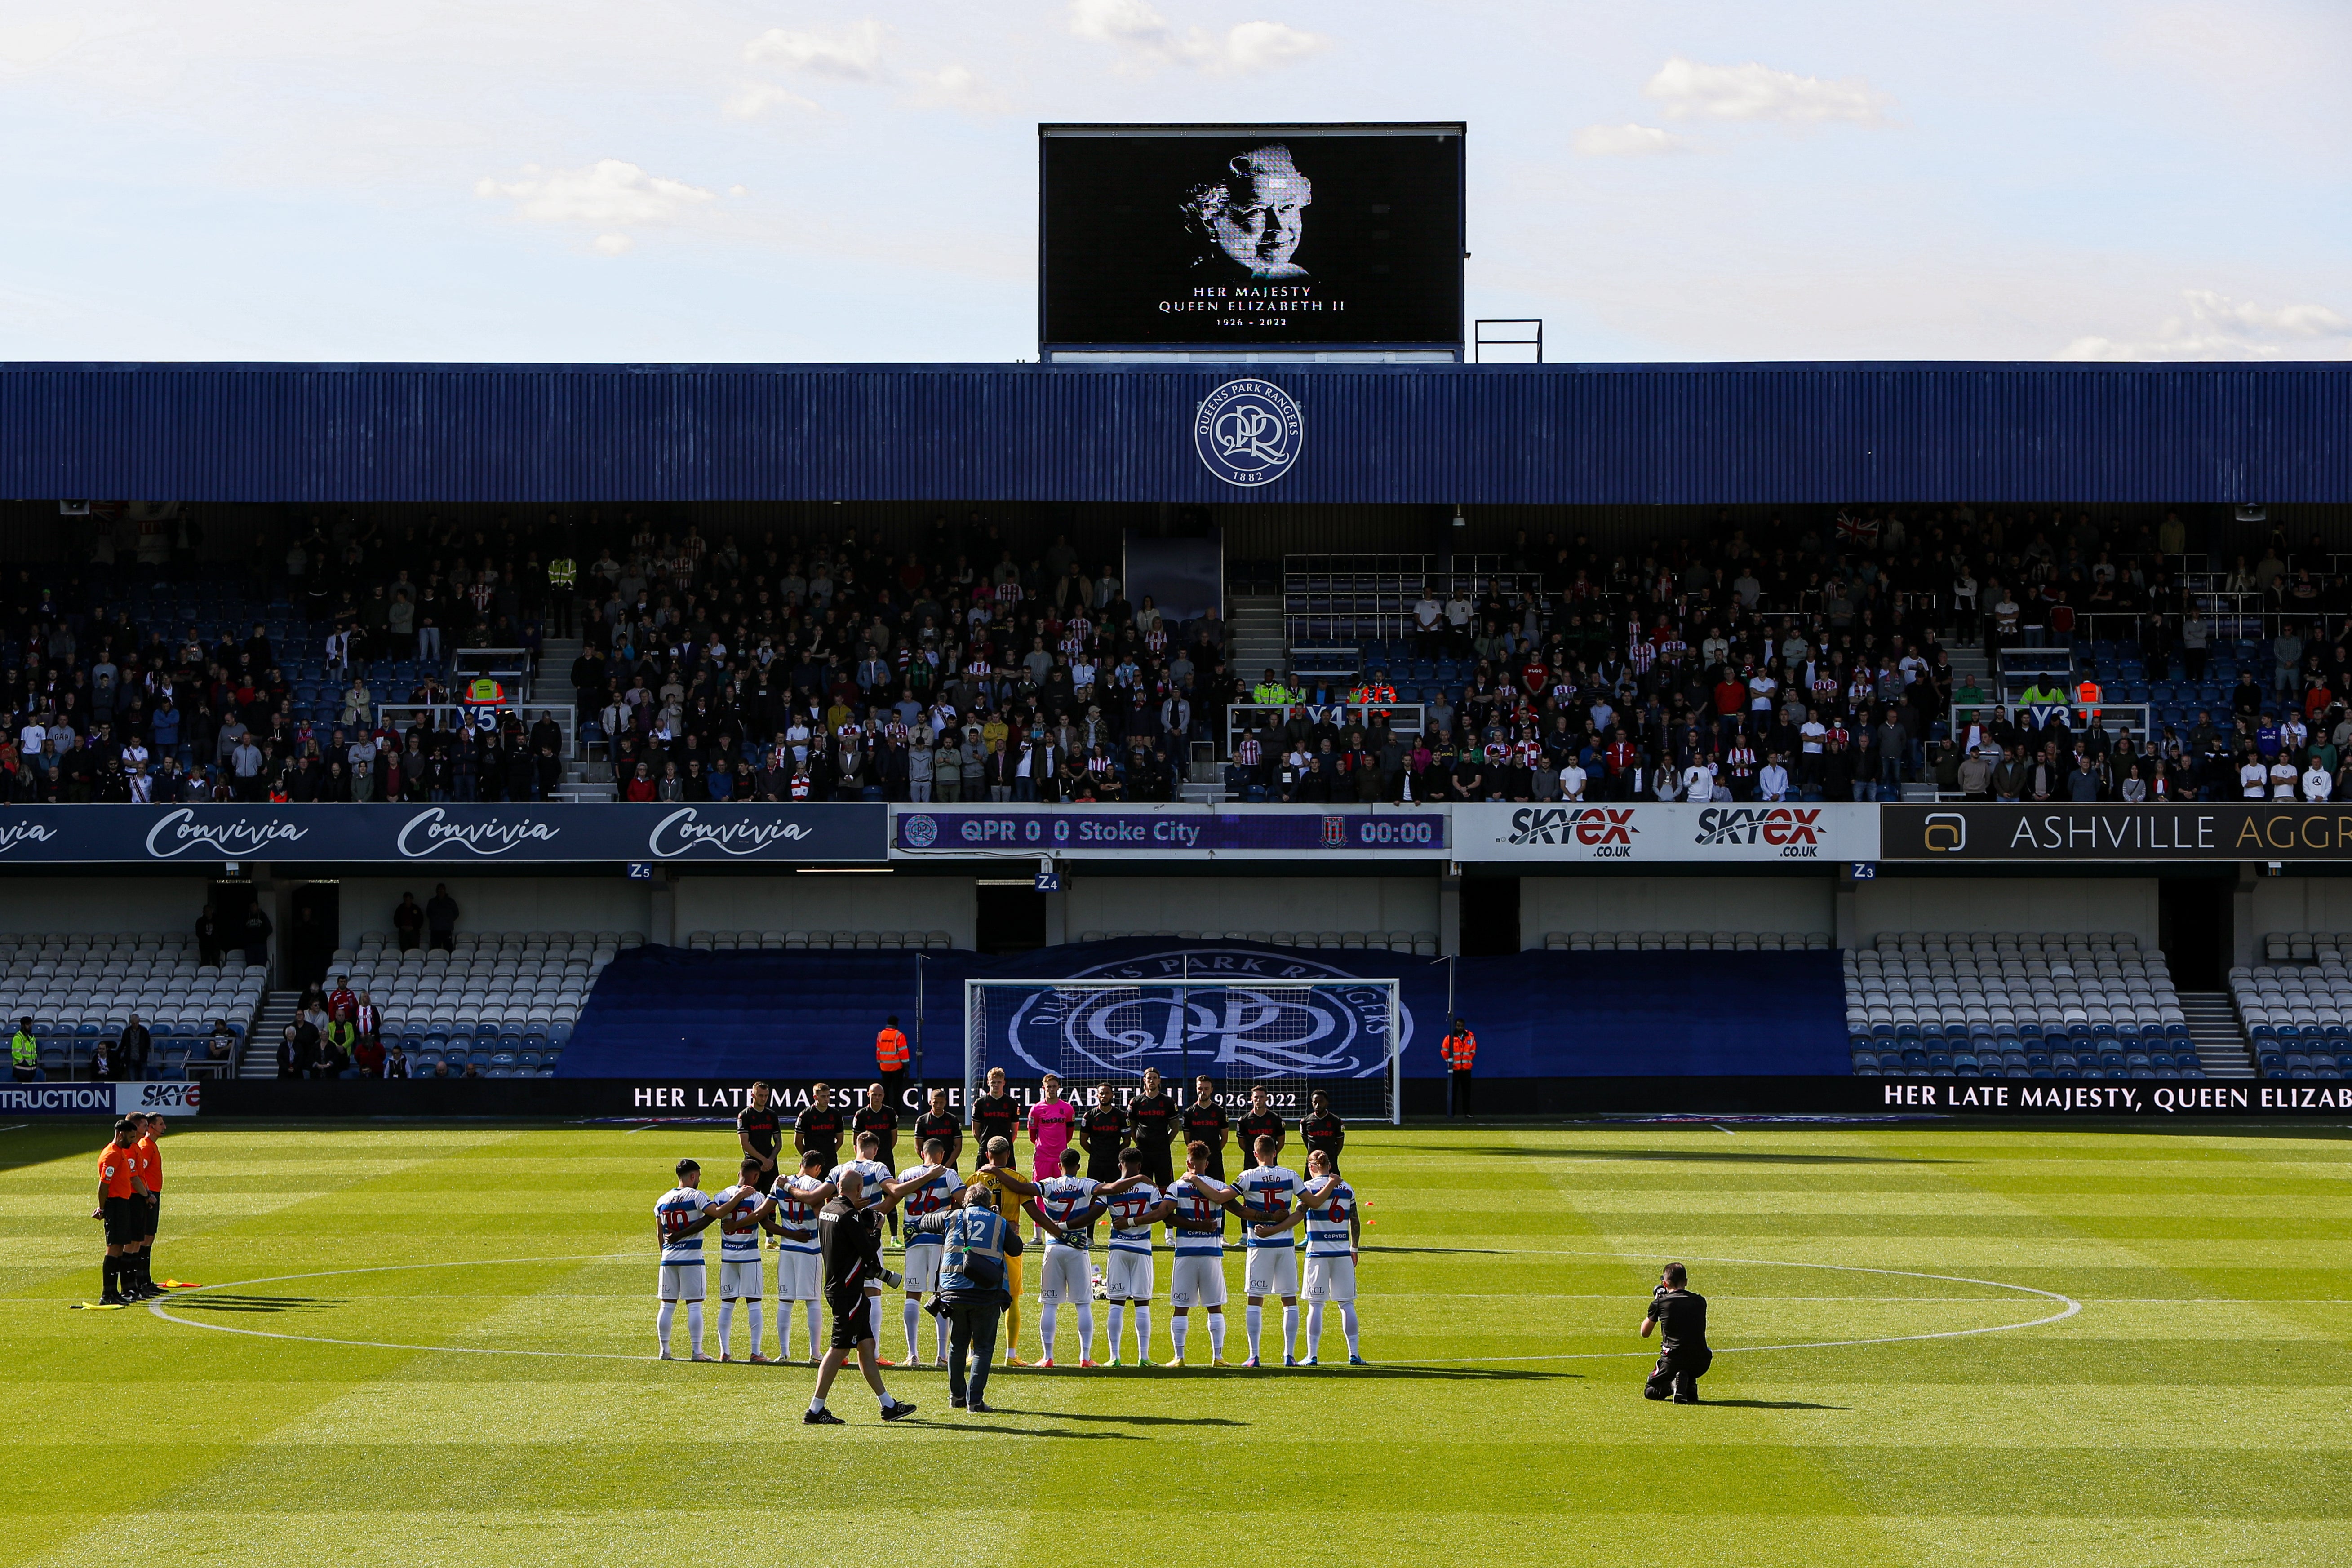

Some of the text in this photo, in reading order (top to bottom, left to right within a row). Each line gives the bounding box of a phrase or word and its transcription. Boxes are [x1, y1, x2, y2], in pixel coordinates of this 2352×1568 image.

[1194, 287, 1310, 298] HER MAJESTY
[1159, 301, 1344, 313] QUEEN ELIZABETH II
[1199, 383, 1298, 435] QUEENS PARK RANGERS
[1234, 472, 1263, 482] 1882
[457, 707, 496, 731] Y5
[1306, 706, 1345, 730] Y4
[2031, 706, 2071, 731] Y3
[146, 809, 308, 857] Convivia
[397, 807, 559, 857] Convivia
[649, 807, 812, 857] Convivia
[961, 820, 1200, 846] QPR 0 0 Stoke City
[1361, 822, 1432, 843] 00:00
[2011, 815, 2352, 848] ASHVILLE AGGR
[1593, 846, 1631, 858] .CO.UK
[1780, 846, 1818, 858] .CO.UK
[631, 864, 650, 878] Z5
[1038, 876, 1057, 890] Z4
[1855, 864, 1873, 878] Z3
[1160, 956, 1267, 972] PARK
[0, 1090, 110, 1108] TRUCTION
[635, 1088, 686, 1107] HER
[1885, 1085, 2352, 1112] HER LATE MAJESTY, QUEEN ELIZAB
[784, 1197, 805, 1224] 17
[907, 1186, 941, 1216] 26
[1058, 1198, 1076, 1223] 7
[1190, 1195, 1211, 1221] 11
[1260, 1188, 1286, 1214] 15
[1329, 1196, 1345, 1223] 6
[662, 1209, 690, 1234] 10
[819, 1211, 839, 1223] macron
[959, 1220, 985, 1242] 32
[1110, 1283, 1125, 1291] GCL
